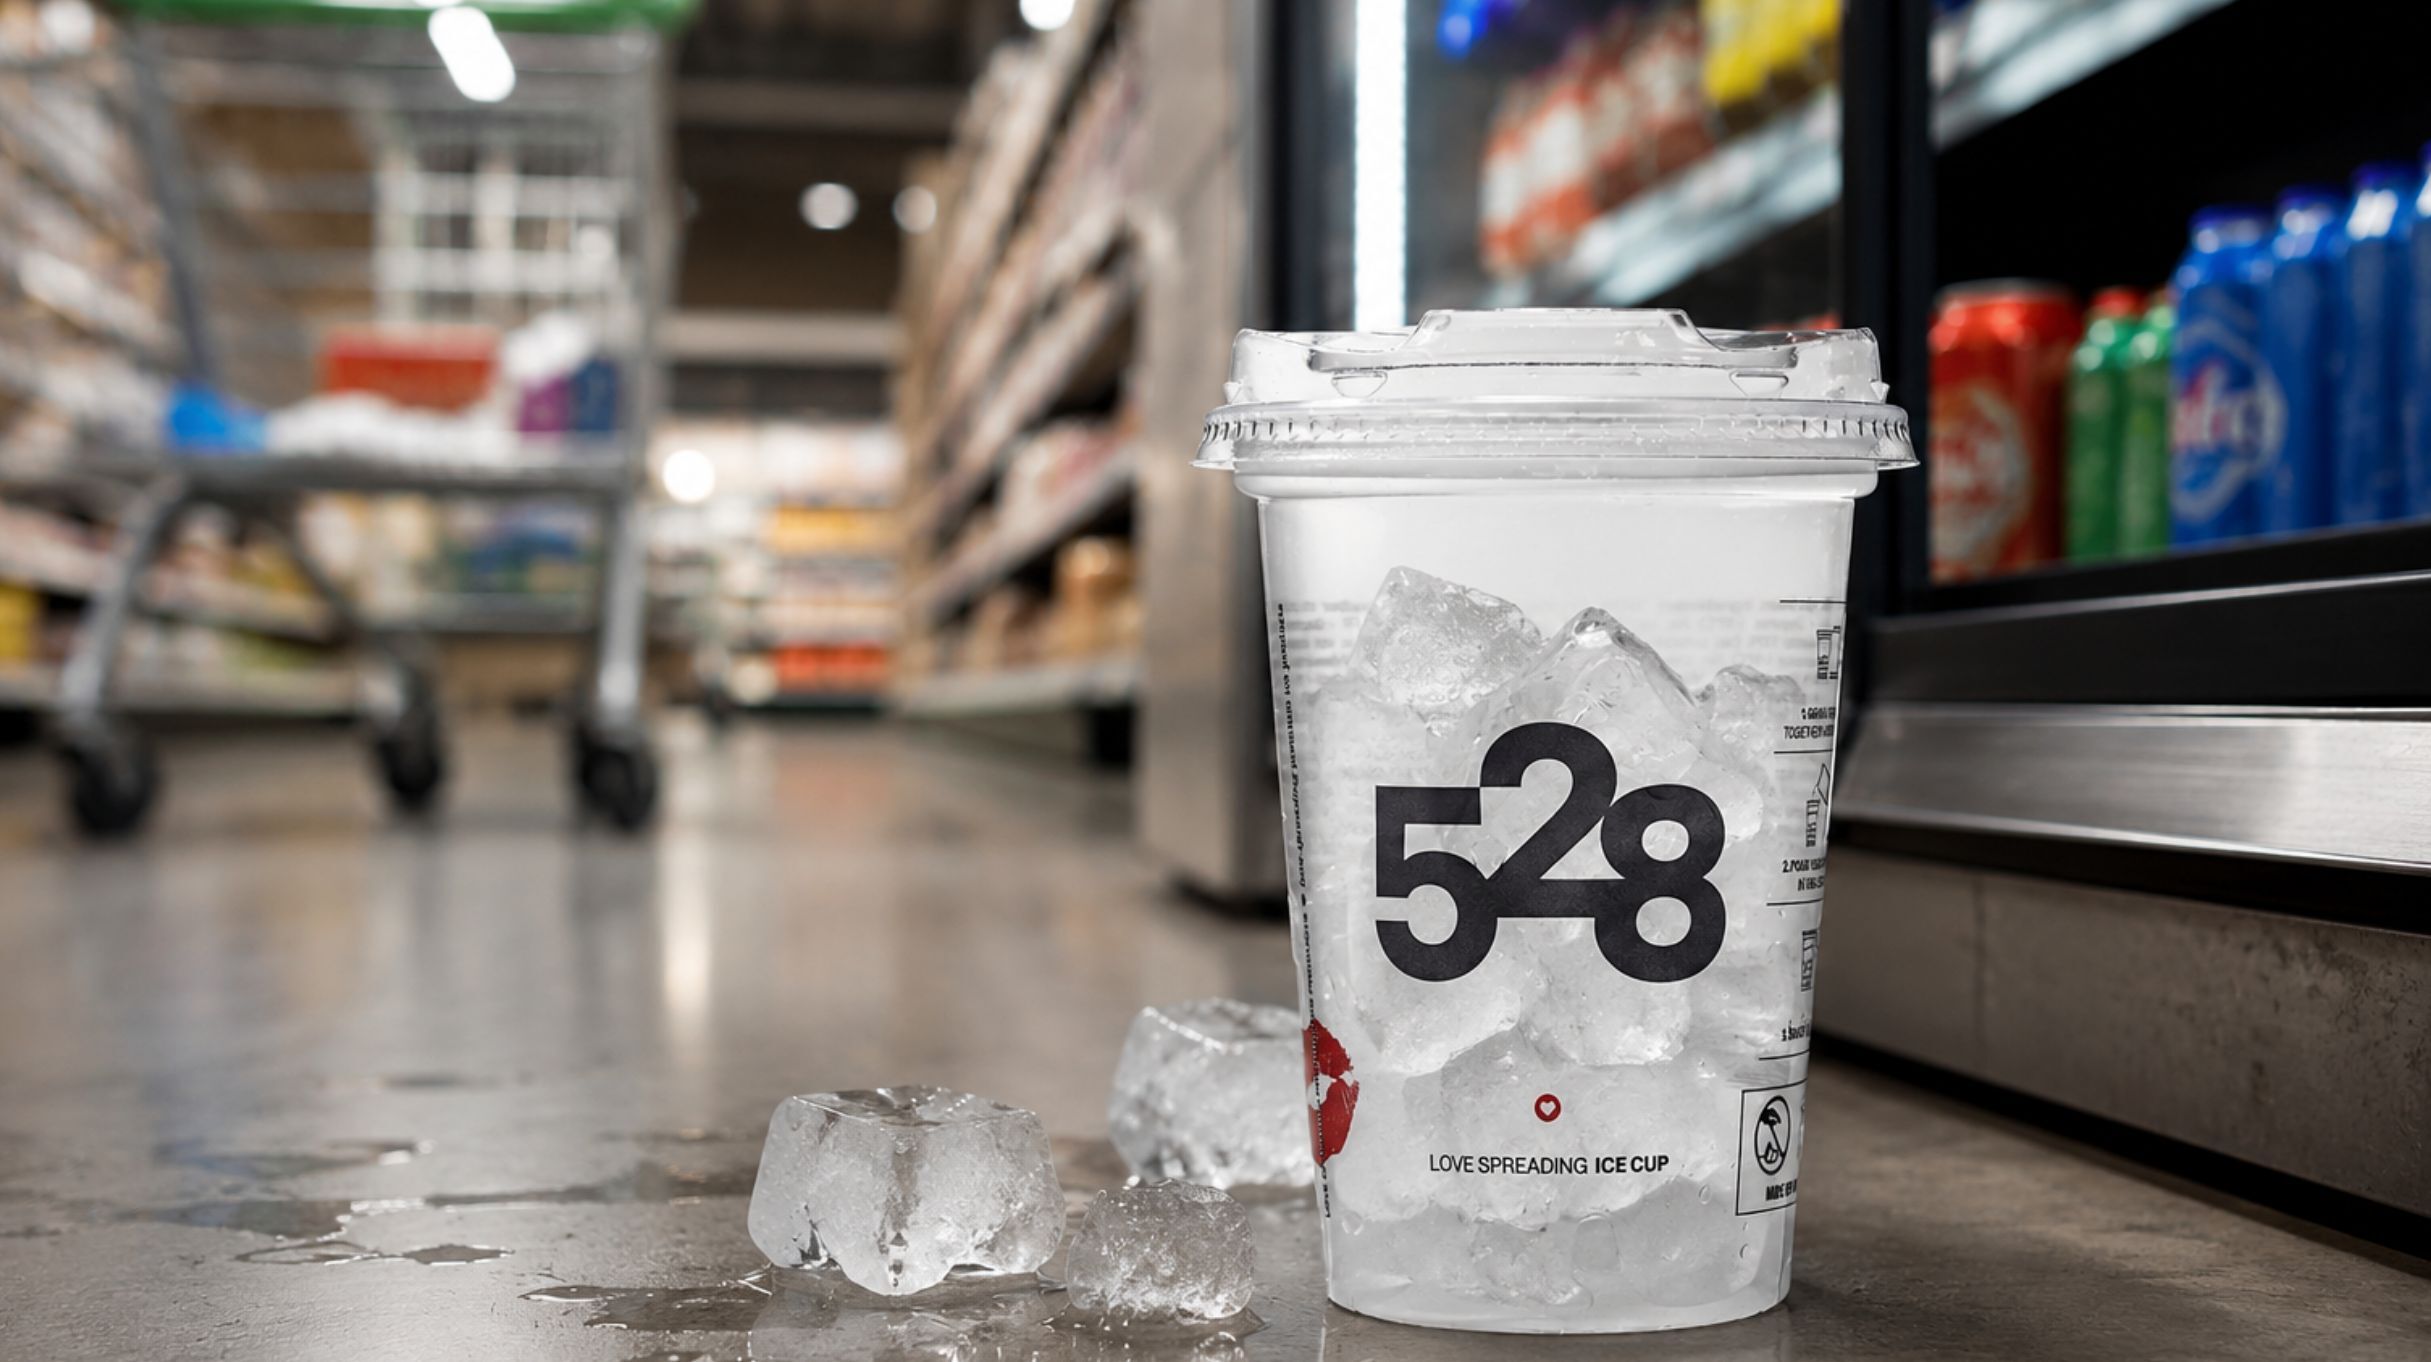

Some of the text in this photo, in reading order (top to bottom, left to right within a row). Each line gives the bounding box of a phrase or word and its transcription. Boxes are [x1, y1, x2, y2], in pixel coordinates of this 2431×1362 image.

[1376, 722, 1725, 982] 528
[1430, 1155, 1670, 1174] LOVE SPREADING ICE CUP
